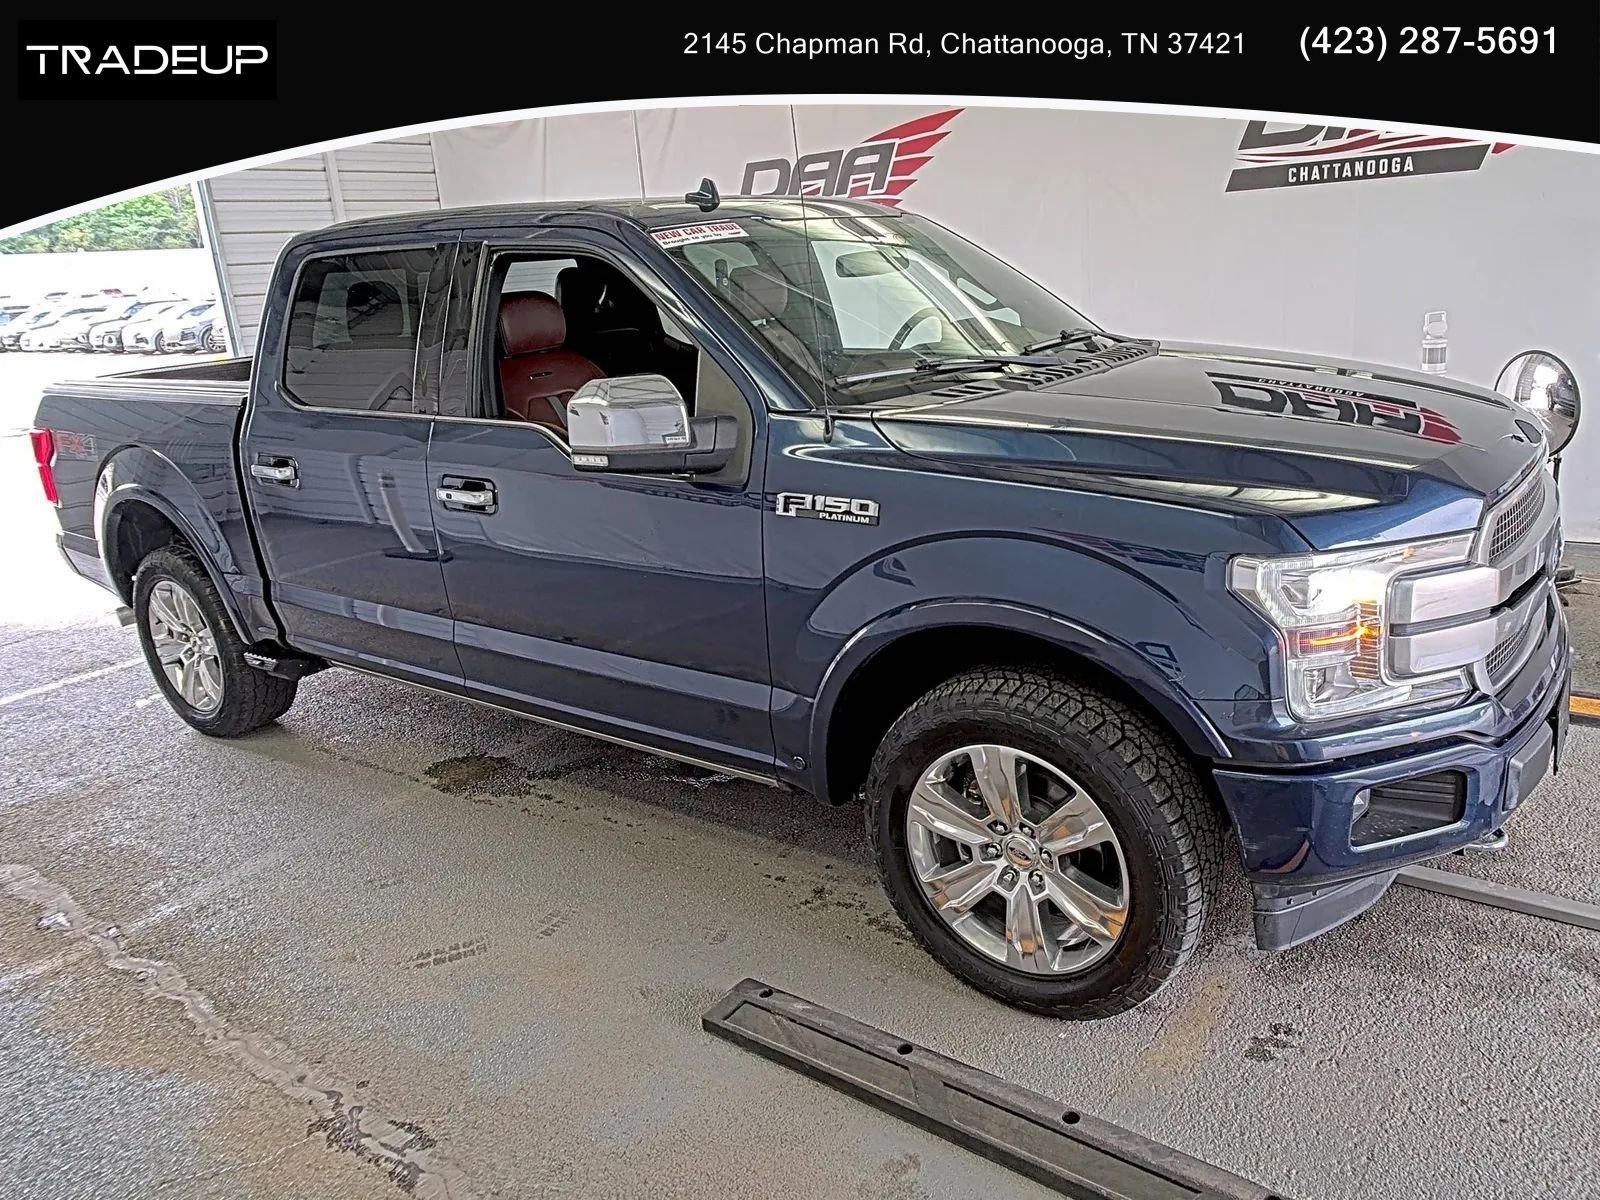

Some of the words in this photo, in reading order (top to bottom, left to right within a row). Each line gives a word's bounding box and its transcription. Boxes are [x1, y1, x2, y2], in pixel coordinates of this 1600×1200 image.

[740, 142, 896, 196] DAA
[1287, 155, 1415, 183] CHATTANOOGA
[654, 230, 682, 241] NEW
[682, 226, 706, 237] CAR
[706, 223, 741, 233] TRADE
[819, 511, 870, 524] PLATINUM
